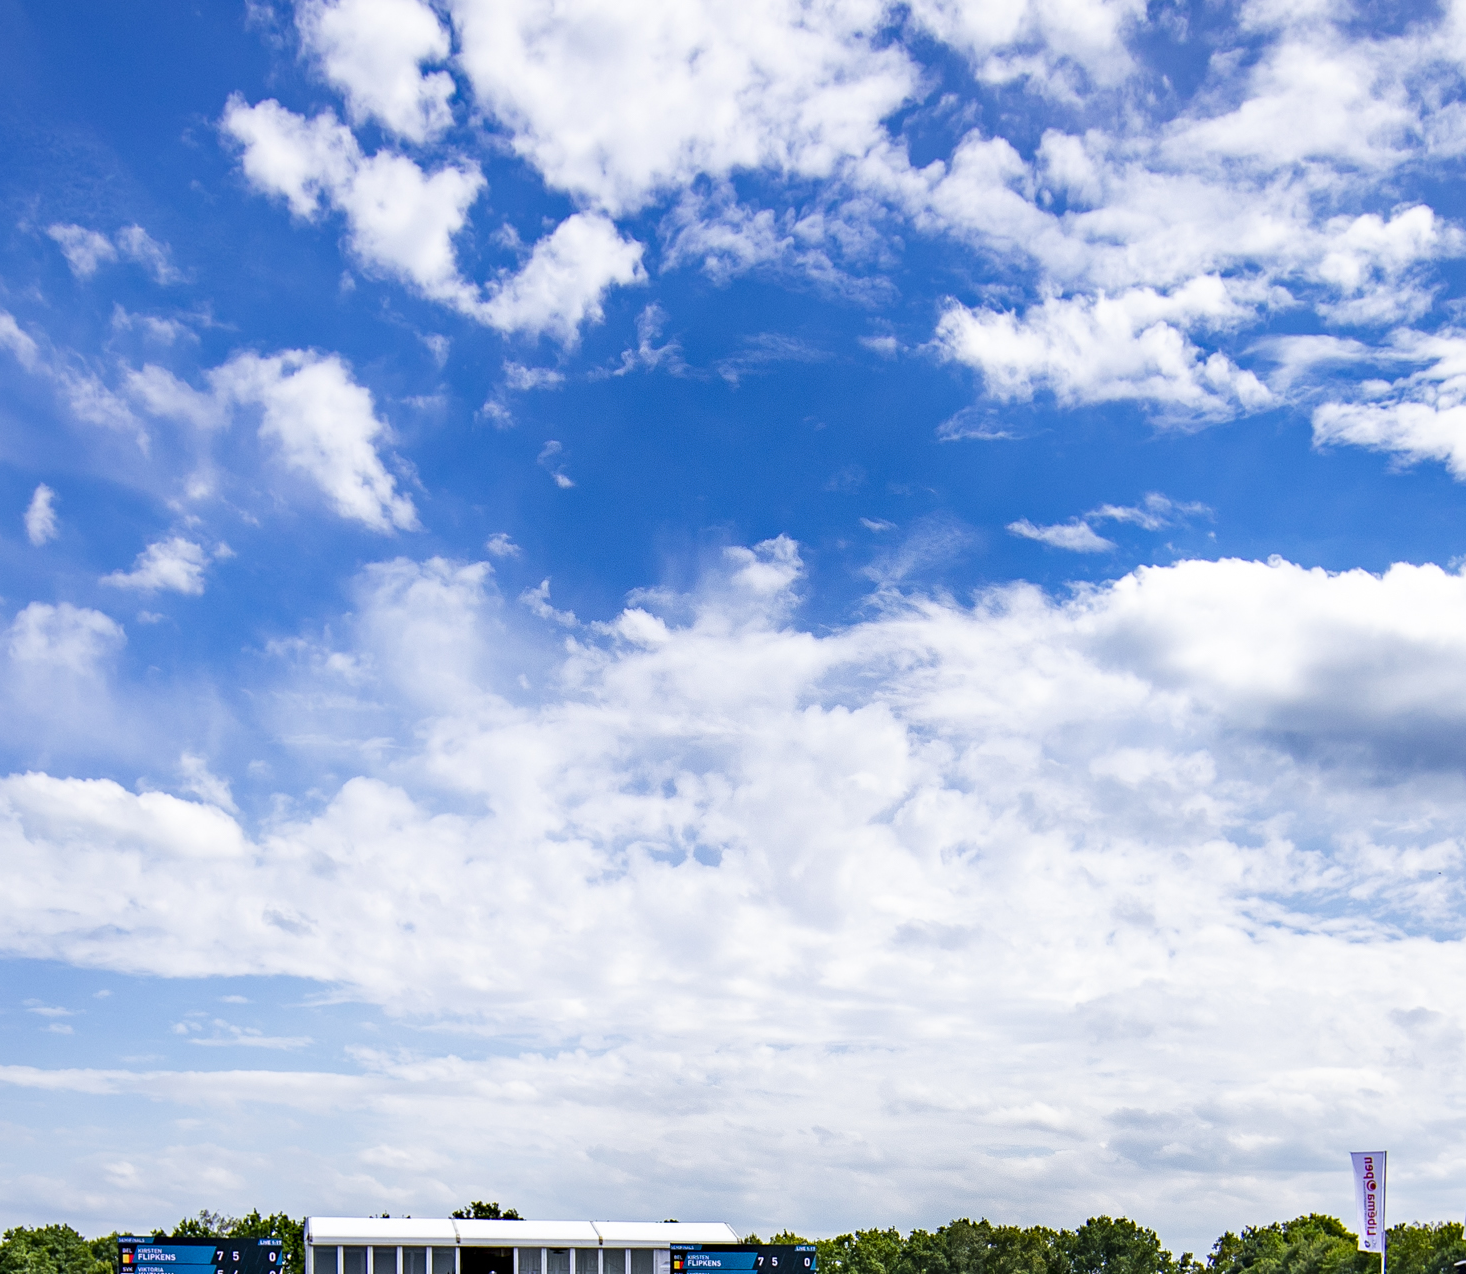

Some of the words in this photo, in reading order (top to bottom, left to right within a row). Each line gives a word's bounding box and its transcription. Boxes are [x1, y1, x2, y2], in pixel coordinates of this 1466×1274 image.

[137, 1253, 176, 1261] FLIPKENS
[217, 1251, 224, 1261] 7
[233, 1251, 240, 1261] 5
[758, 1257, 764, 1266] 7
[771, 1257, 778, 1266] 5
